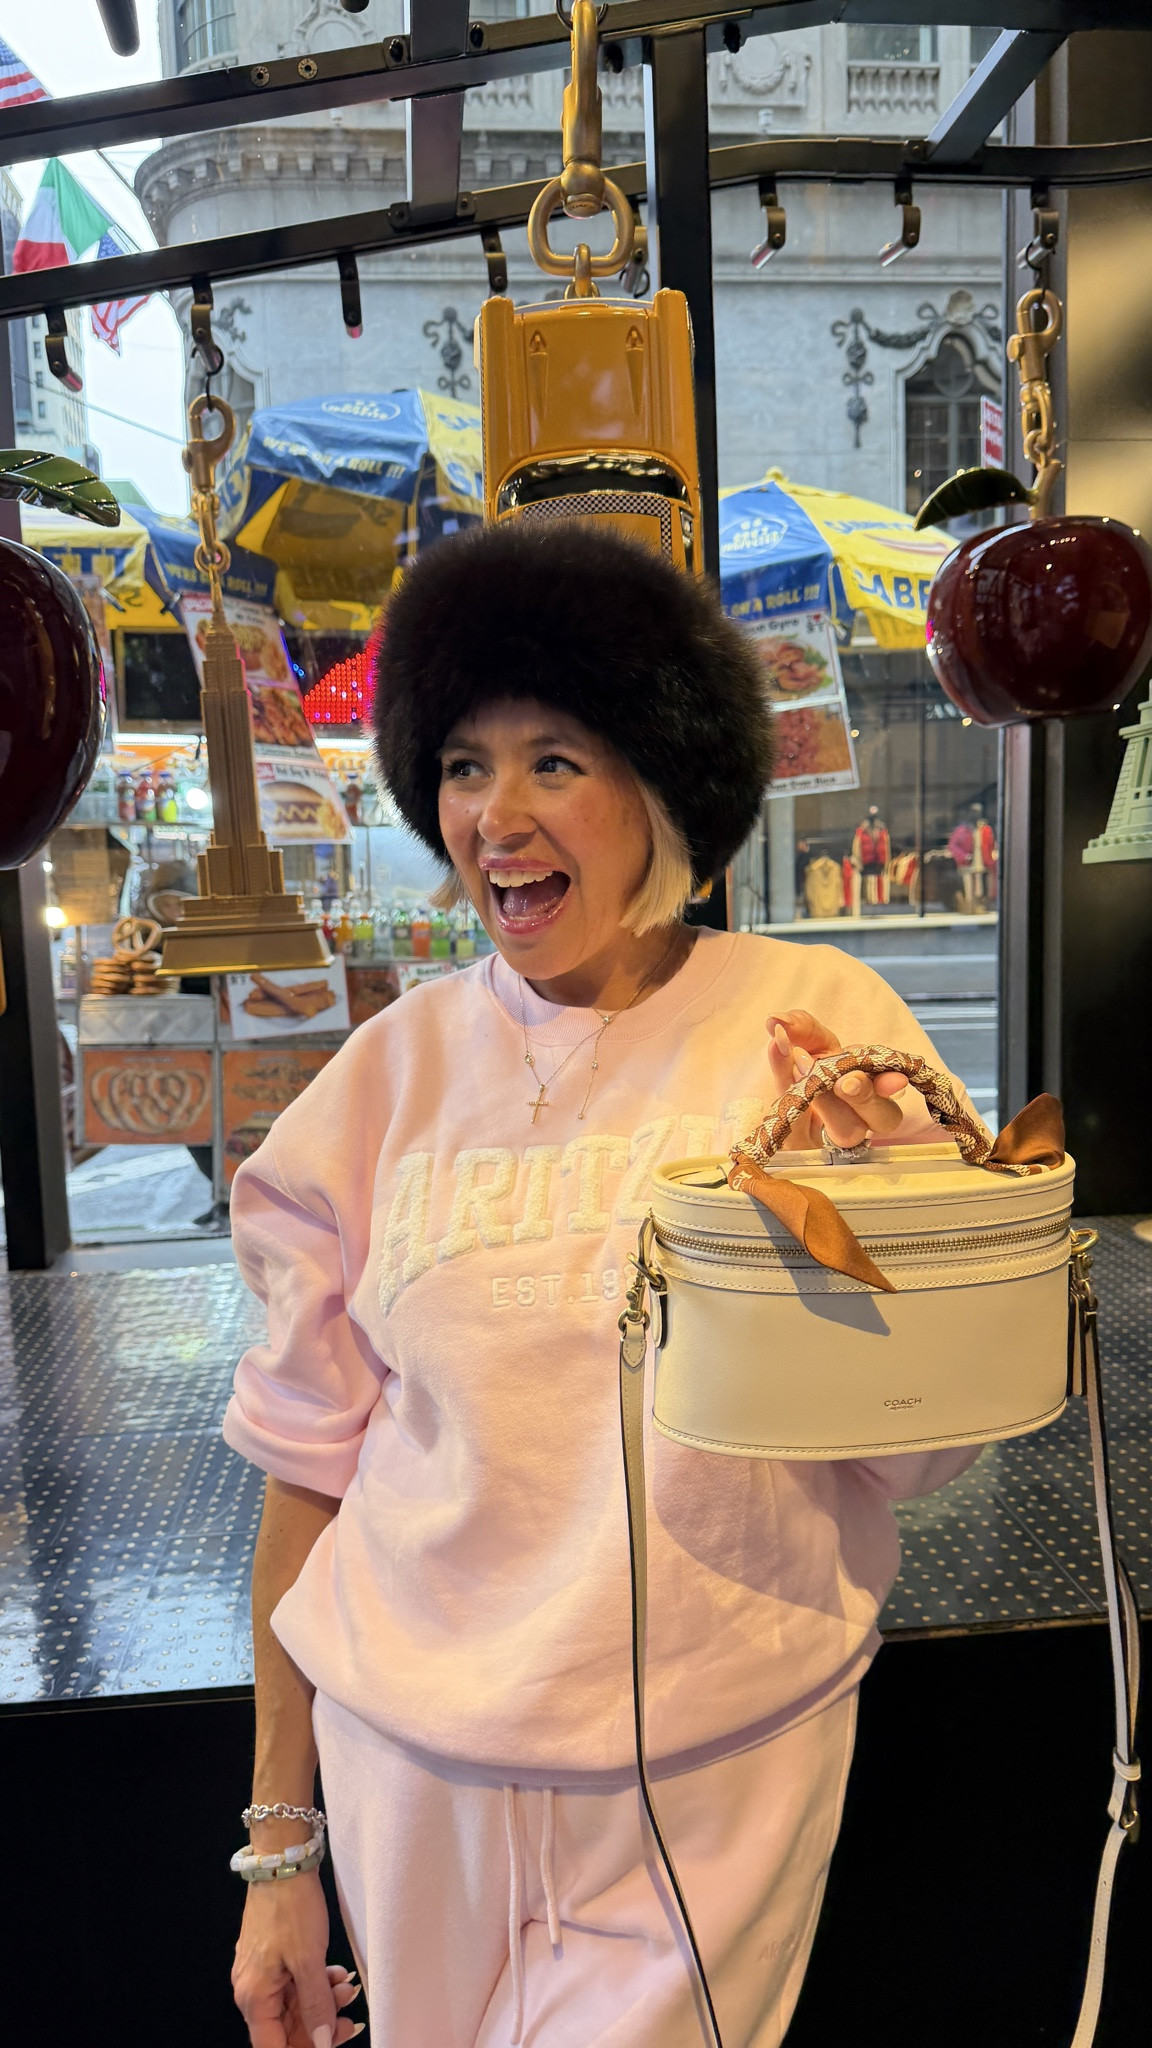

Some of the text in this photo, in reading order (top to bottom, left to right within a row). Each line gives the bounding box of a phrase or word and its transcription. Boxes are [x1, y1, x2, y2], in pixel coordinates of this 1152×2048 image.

[348, 457, 383, 476] ROLL
[765, 588, 802, 609] ROLL
[884, 1397, 922, 1407] COACH
